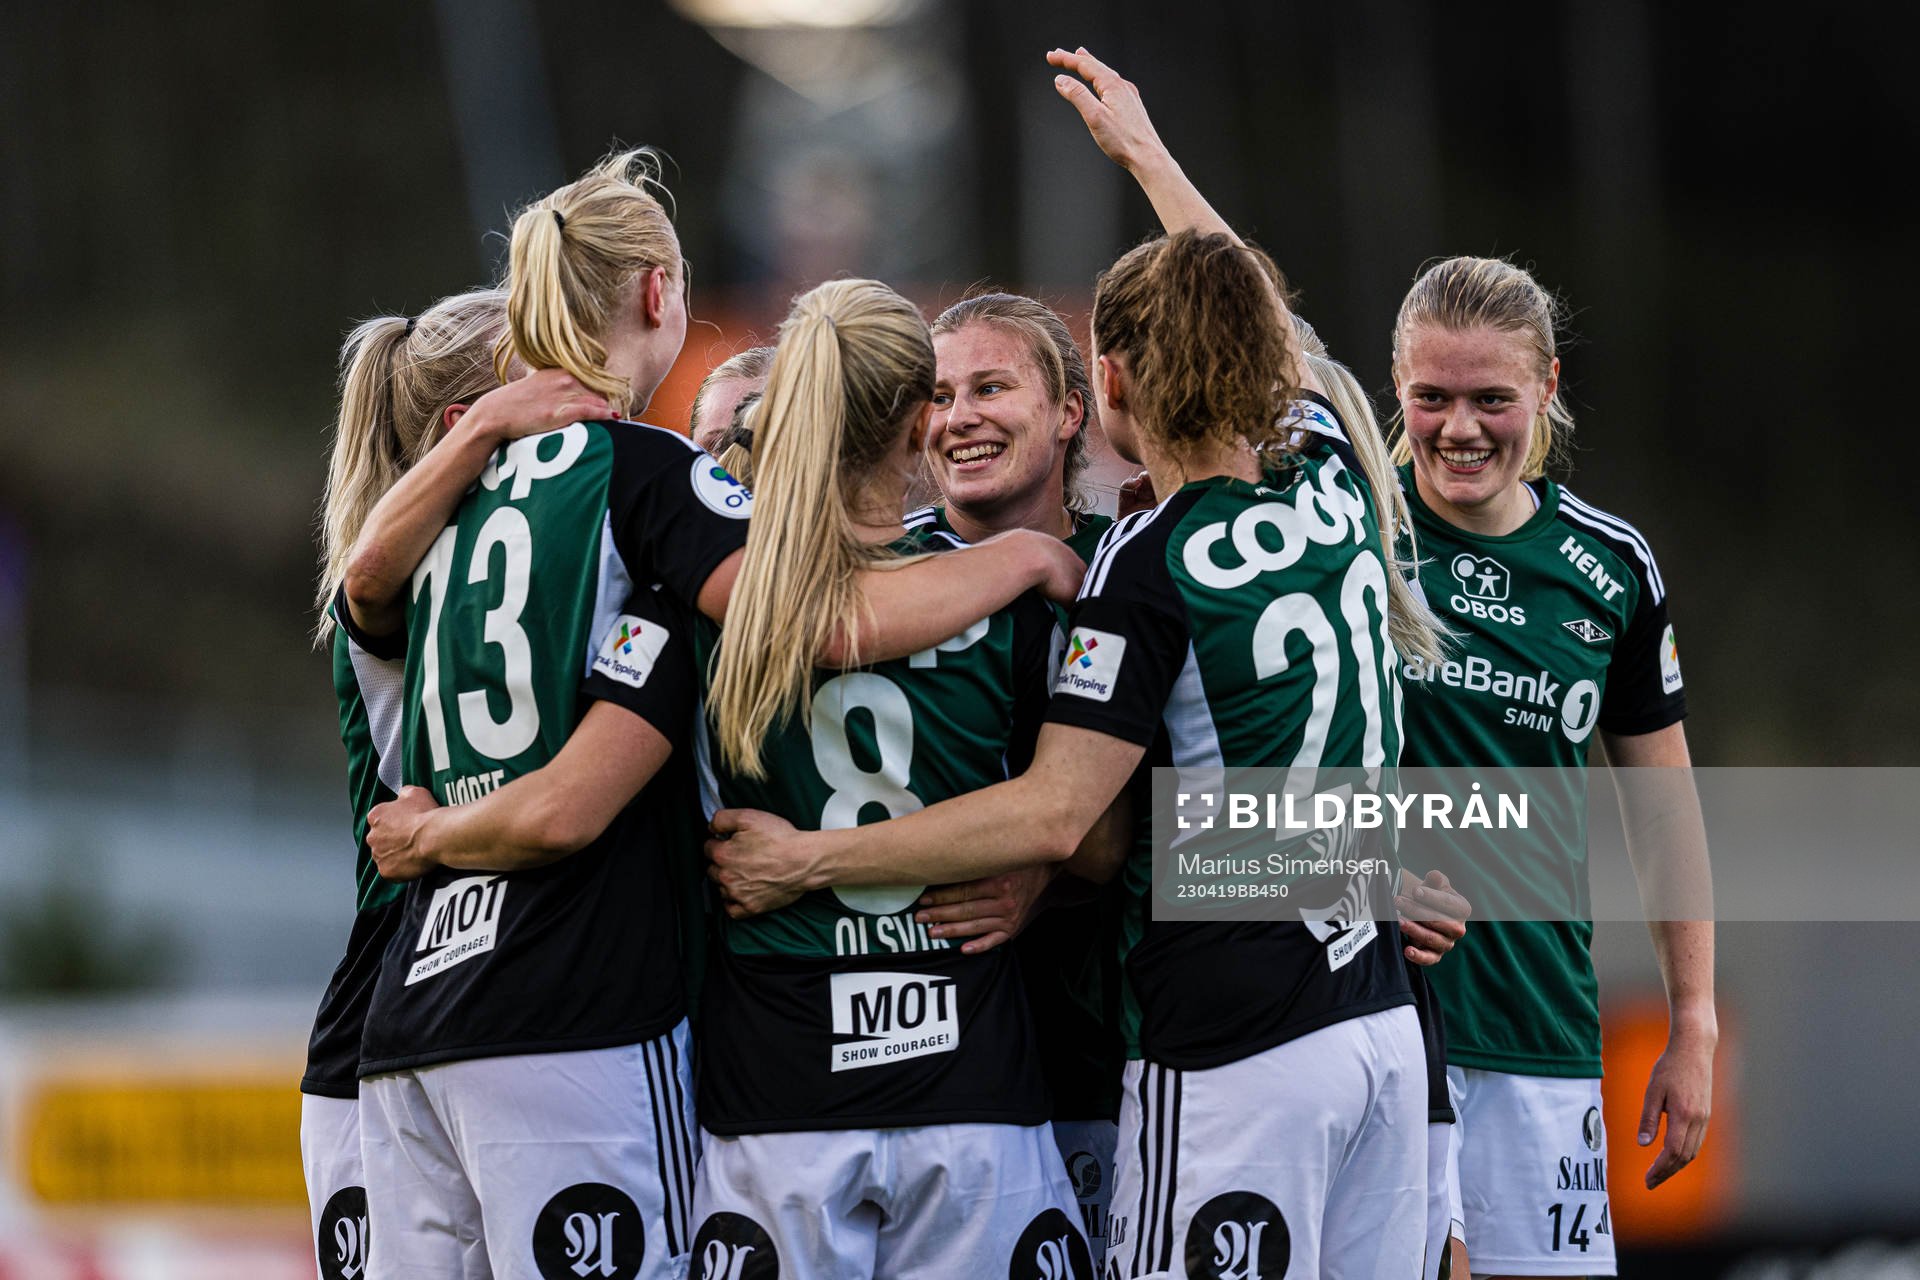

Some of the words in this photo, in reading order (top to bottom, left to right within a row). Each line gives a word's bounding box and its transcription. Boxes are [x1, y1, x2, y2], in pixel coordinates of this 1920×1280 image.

[1559, 535, 1625, 601] HENT
[1450, 594, 1527, 626] OBOS
[412, 505, 540, 772] 13
[1070, 673, 1108, 696] Tipping
[1402, 655, 1560, 708] areBank
[1503, 707, 1553, 733] SMN
[811, 671, 928, 916] 8
[426, 879, 502, 951] MOT
[415, 958, 442, 977] SHOW
[443, 934, 490, 964] COURAGE!
[850, 980, 957, 1034] MOT
[841, 1047, 879, 1063] SHOW
[884, 1033, 950, 1056] COURAGE!
[1547, 1203, 1590, 1252] 14
